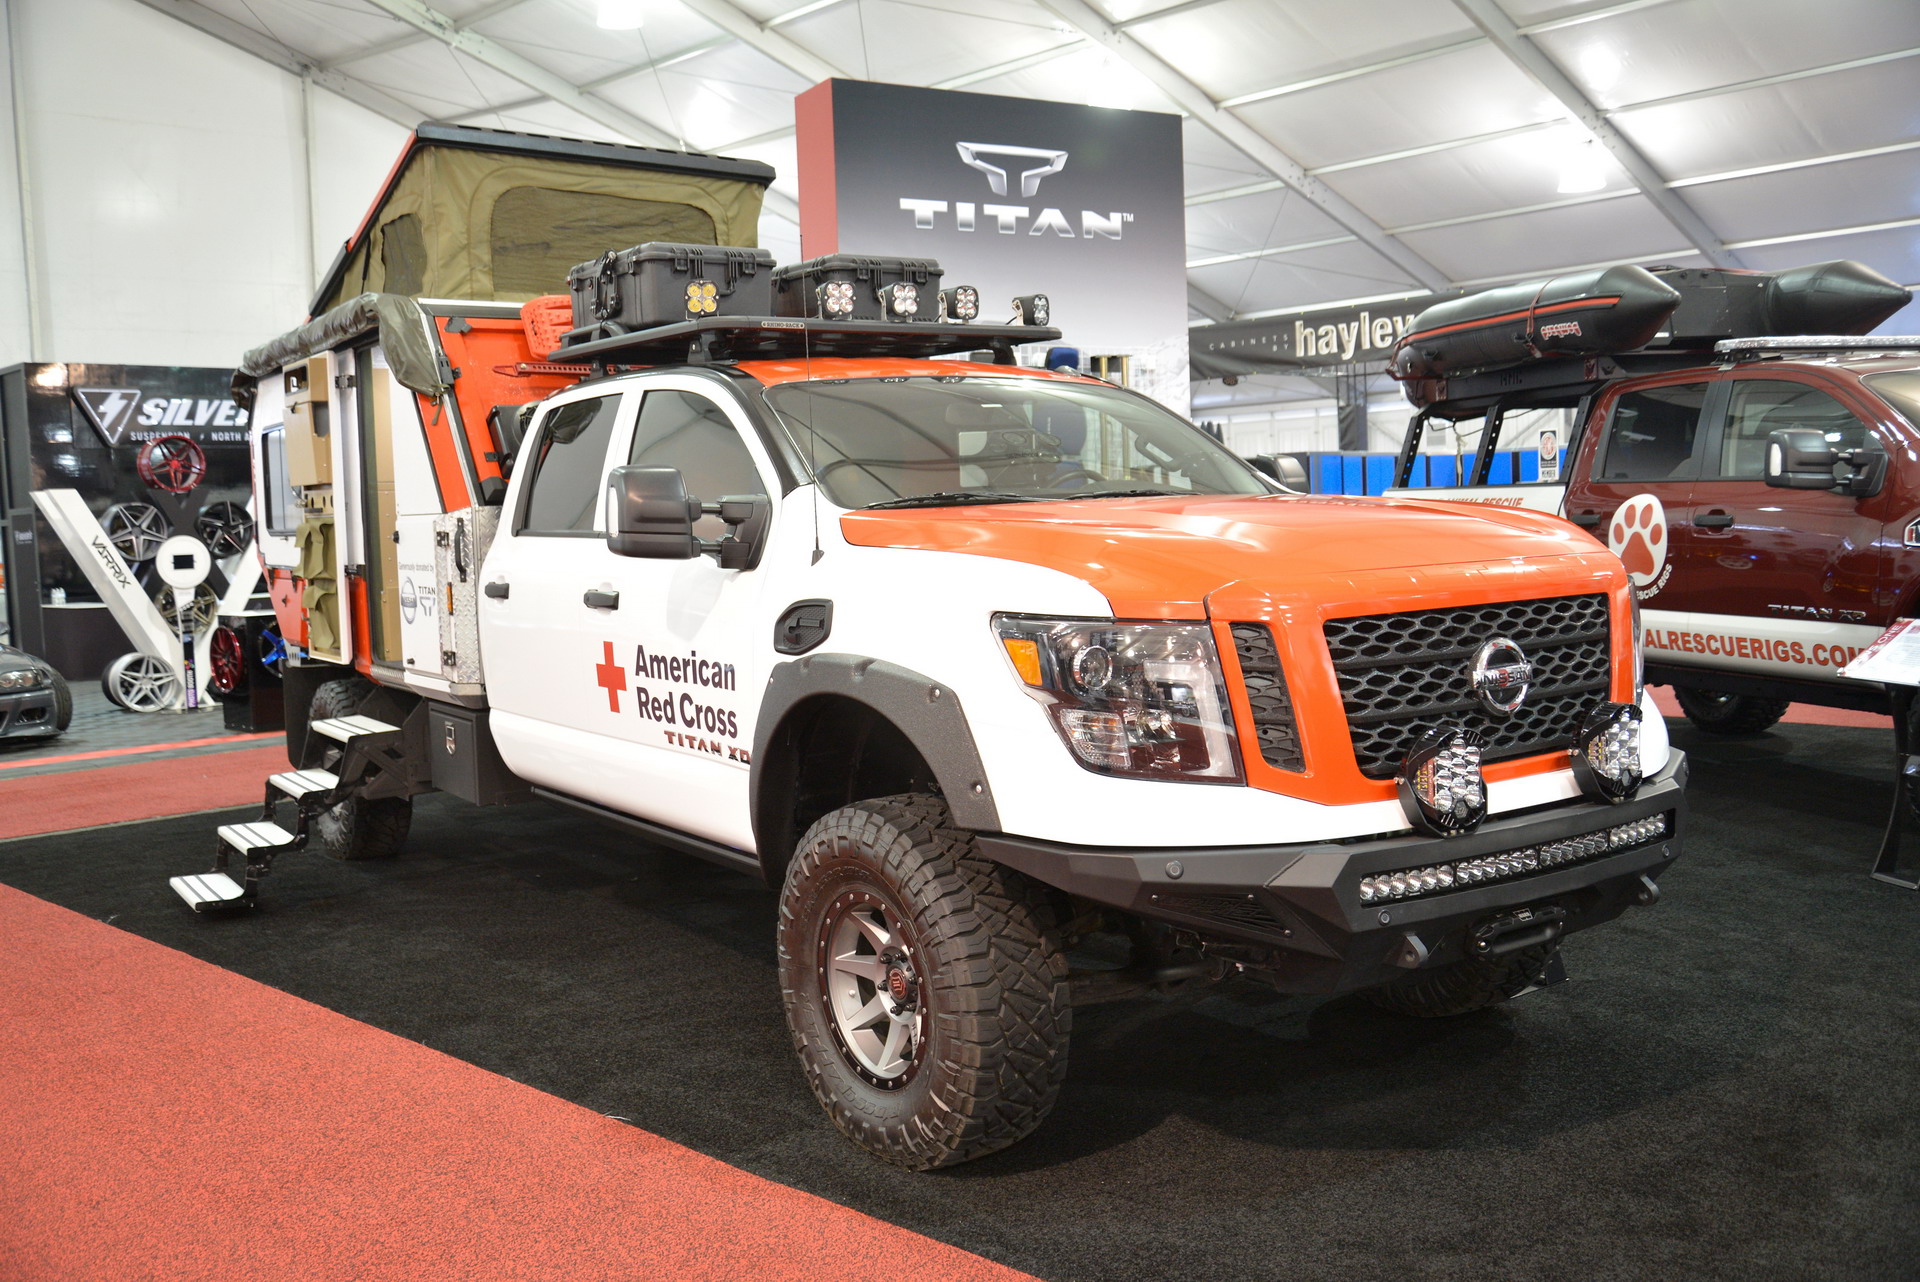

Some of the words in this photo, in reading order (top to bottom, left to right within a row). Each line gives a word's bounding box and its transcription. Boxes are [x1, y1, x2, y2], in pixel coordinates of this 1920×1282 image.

[211, 431, 241, 441] NORTH
[418, 585, 436, 595] TITAN
[1768, 604, 1832, 619] TITAN
[635, 644, 736, 691] American
[1481, 669, 1532, 686] NISSAN
[636, 686, 676, 725] Red
[679, 692, 738, 739] Cross
[664, 730, 723, 757] TITAN
